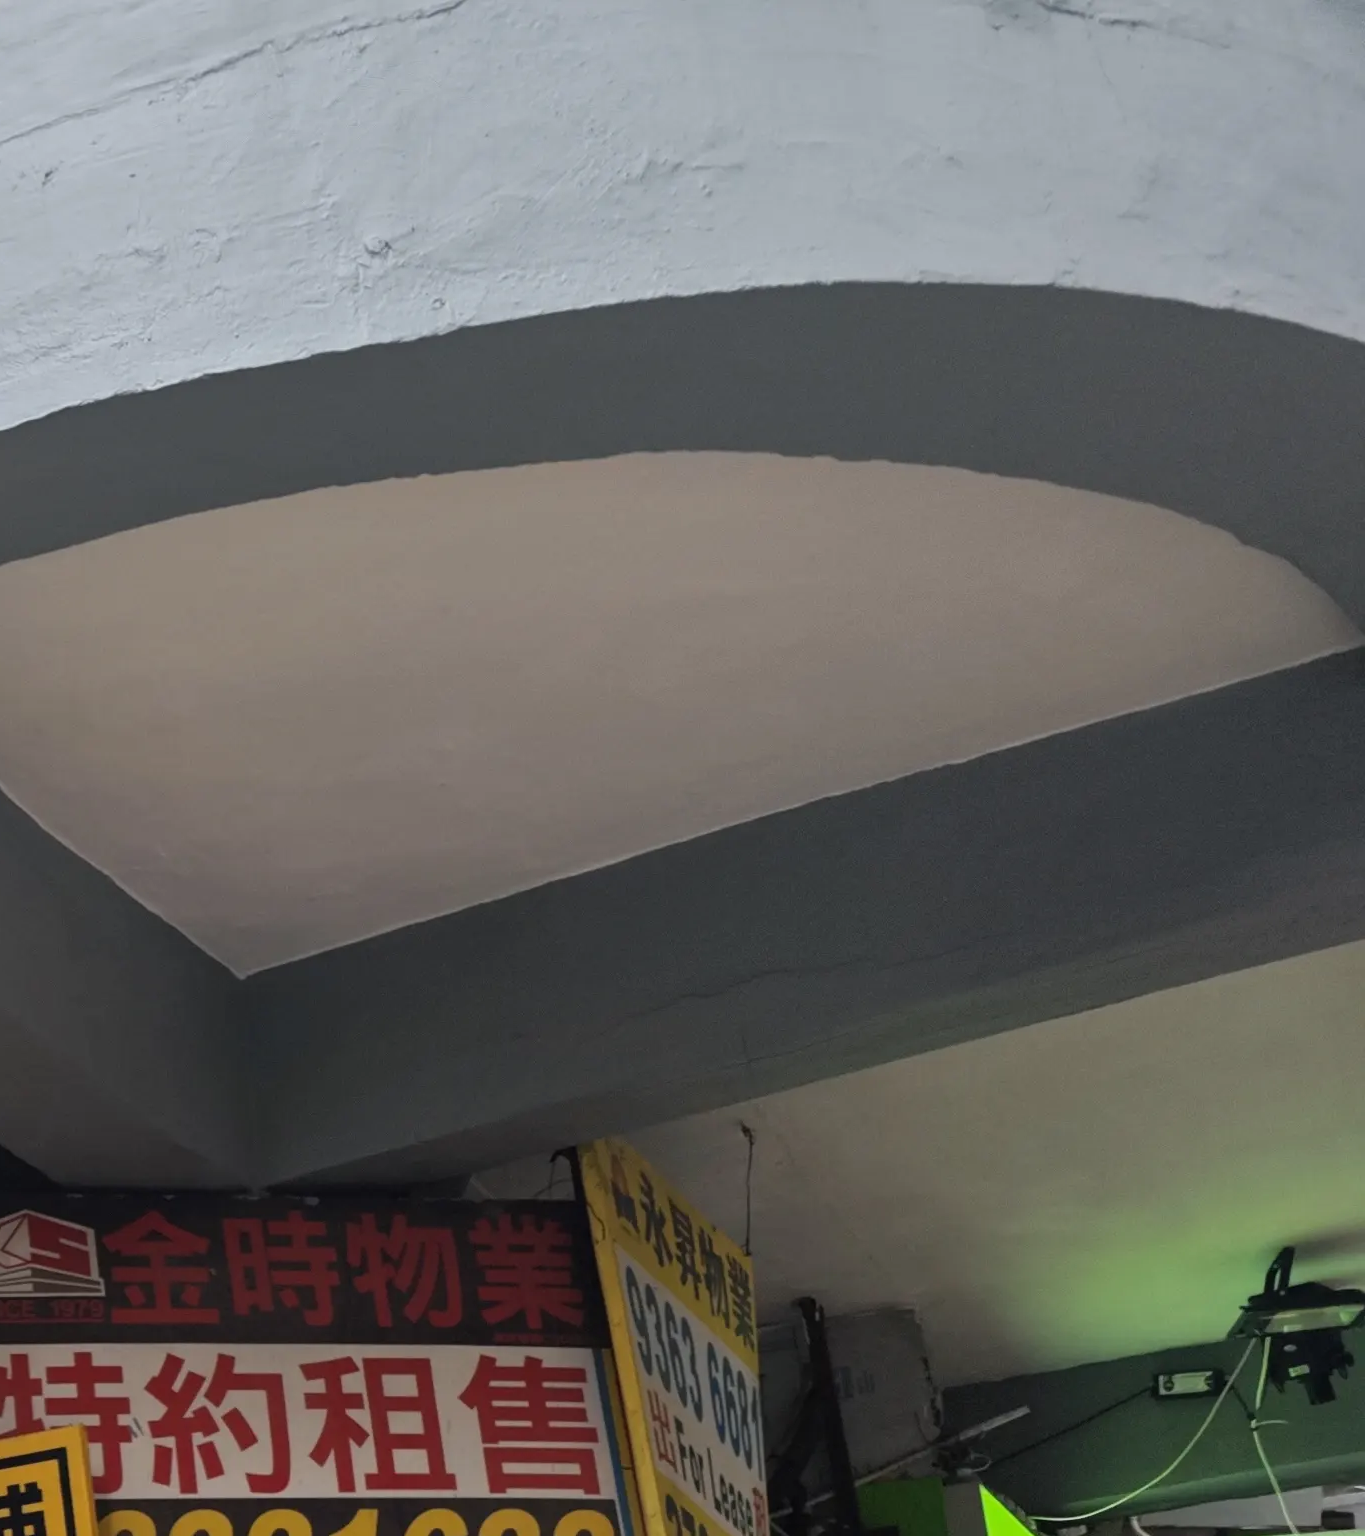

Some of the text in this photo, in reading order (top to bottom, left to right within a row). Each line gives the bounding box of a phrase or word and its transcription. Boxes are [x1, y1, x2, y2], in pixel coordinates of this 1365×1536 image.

[49, 1299, 105, 1318] 1979
[101, 1208, 589, 1332] 金時物業
[623, 1265, 767, 1482] 9363 6681
[674, 1418, 705, 1497] For
